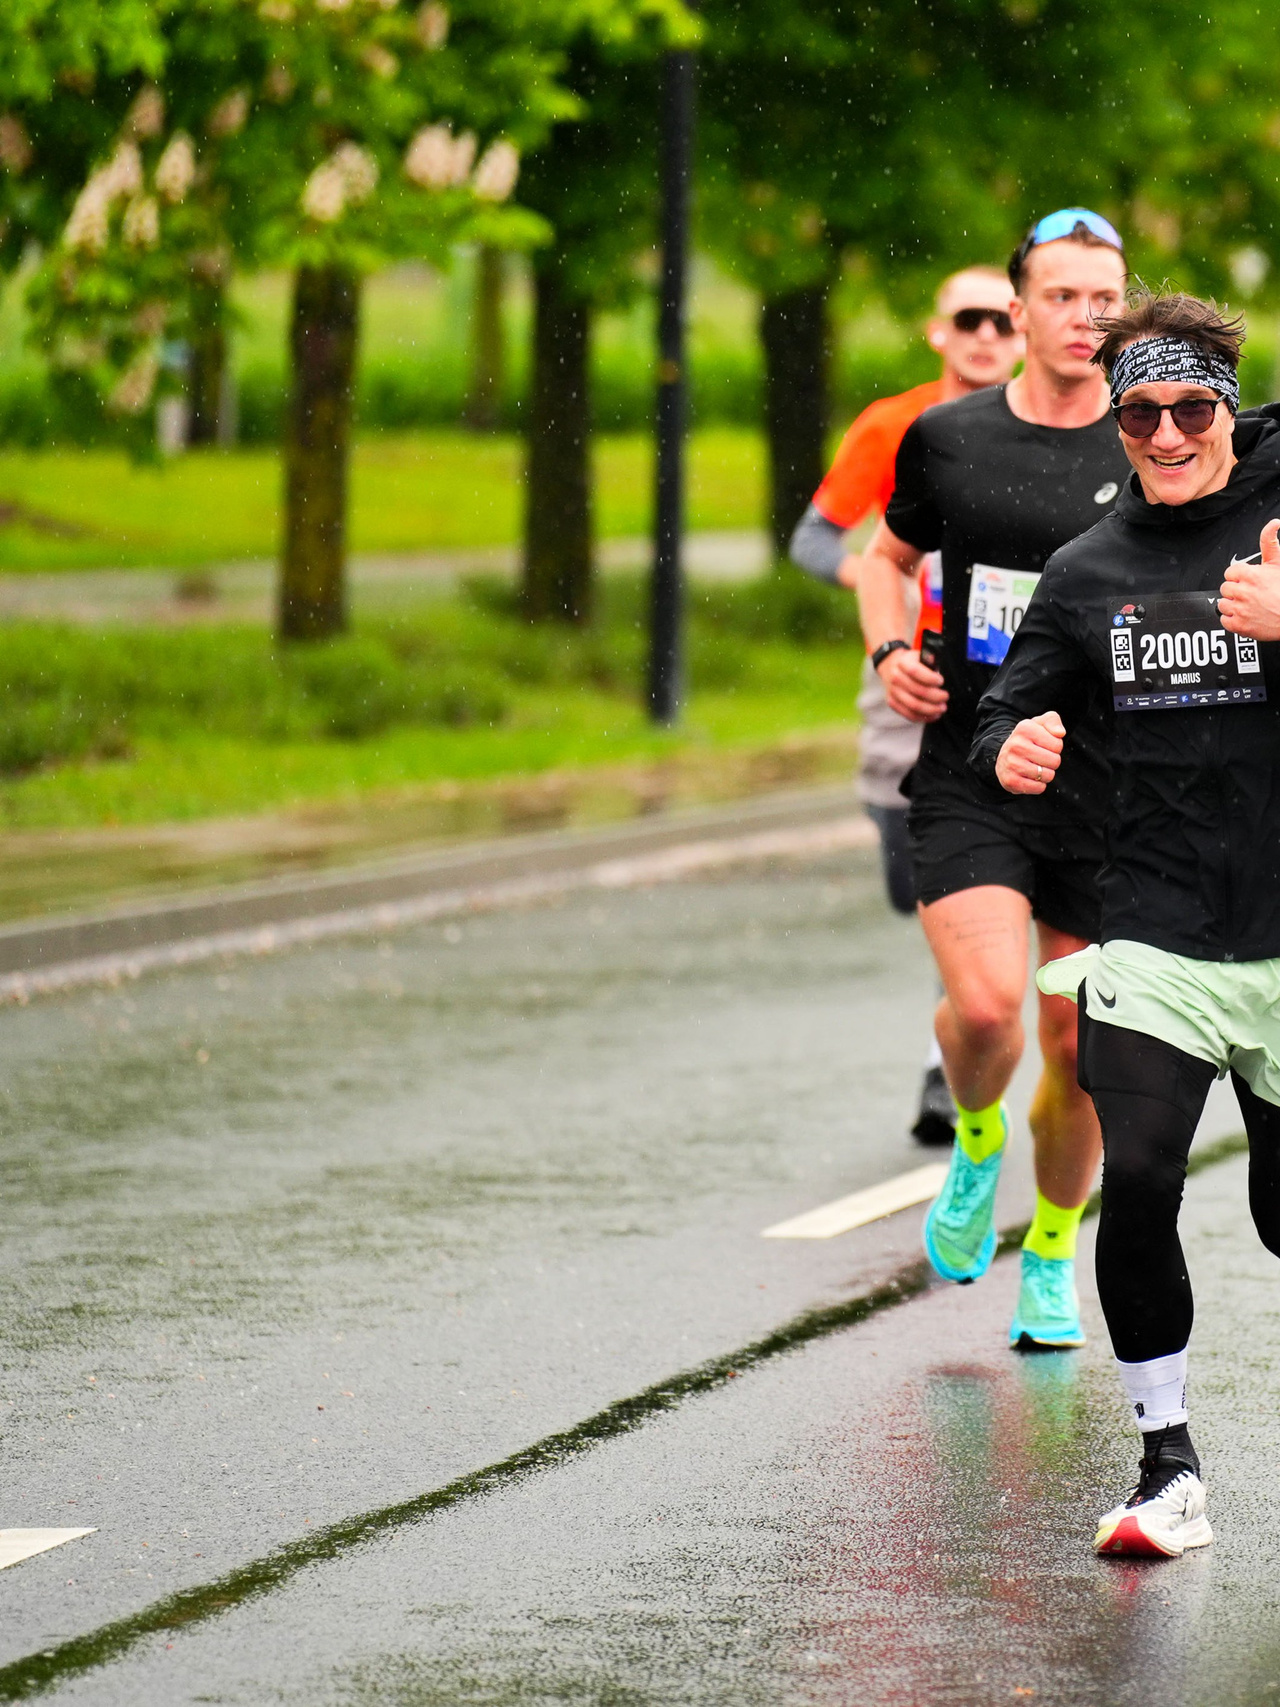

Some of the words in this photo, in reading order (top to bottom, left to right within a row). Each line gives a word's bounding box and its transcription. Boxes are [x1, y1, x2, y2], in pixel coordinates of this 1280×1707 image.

[1147, 344, 1168, 355] JUST
[1136, 354, 1149, 364] DO
[1146, 361, 1156, 369] DO
[1165, 353, 1179, 362] JUST
[1179, 357, 1199, 365] JUST
[1147, 365, 1167, 375] JUST
[1167, 363, 1182, 371] DO
[1149, 373, 1160, 381] IT.
[1140, 629, 1228, 670] 20005
[1170, 672, 1201, 685] MARIUS
